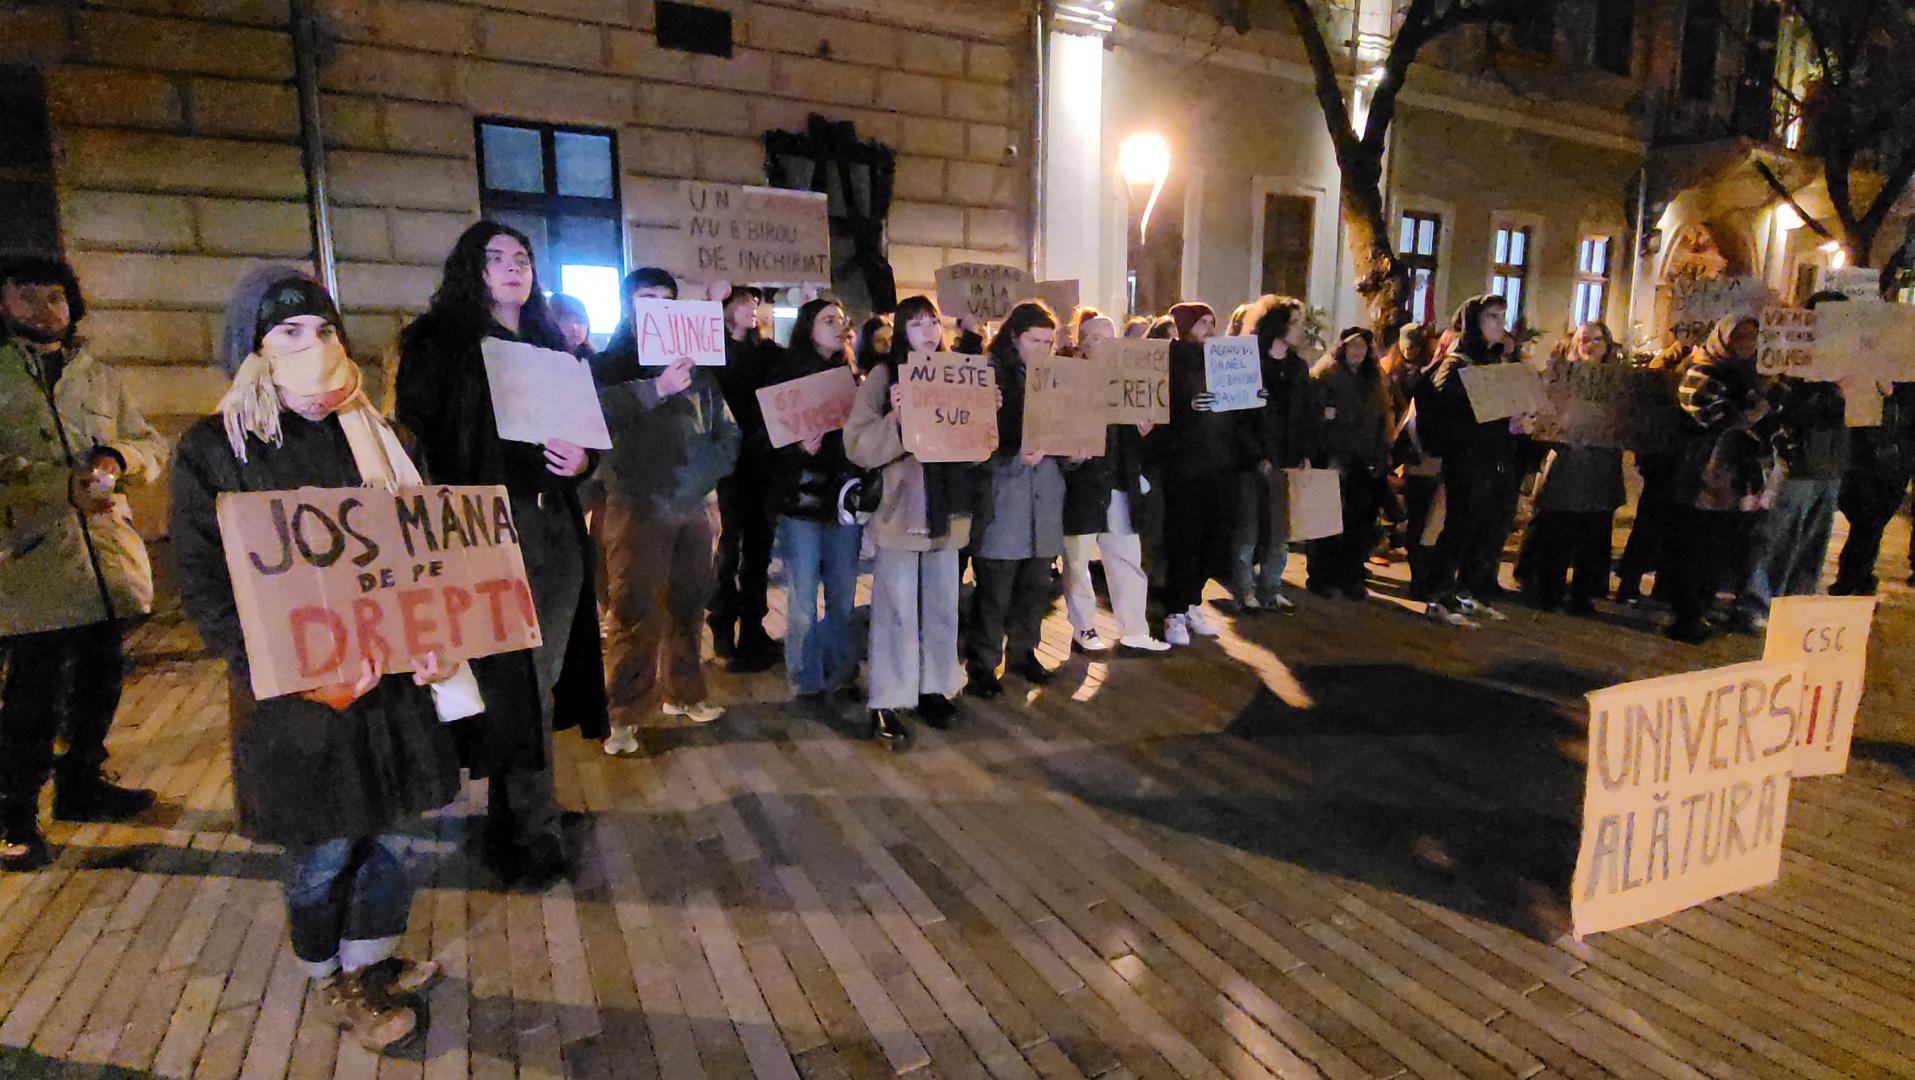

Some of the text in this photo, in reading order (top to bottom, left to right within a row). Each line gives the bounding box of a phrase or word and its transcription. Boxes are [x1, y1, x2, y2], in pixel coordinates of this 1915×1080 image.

[687, 188, 731, 213] UN
[689, 216, 720, 239] NU
[746, 222, 799, 245] BIROU
[698, 245, 729, 272] DE
[640, 307, 723, 357] AJUNGE
[909, 364, 990, 388] NU ESTE
[934, 406, 971, 426] SUB
[248, 486, 519, 576] JOS MÂNA
[357, 560, 444, 593] DE PE
[288, 578, 537, 679] DREPT!
[1802, 626, 1847, 653] CSC
[1583, 770, 1794, 902] ALĂTURA
